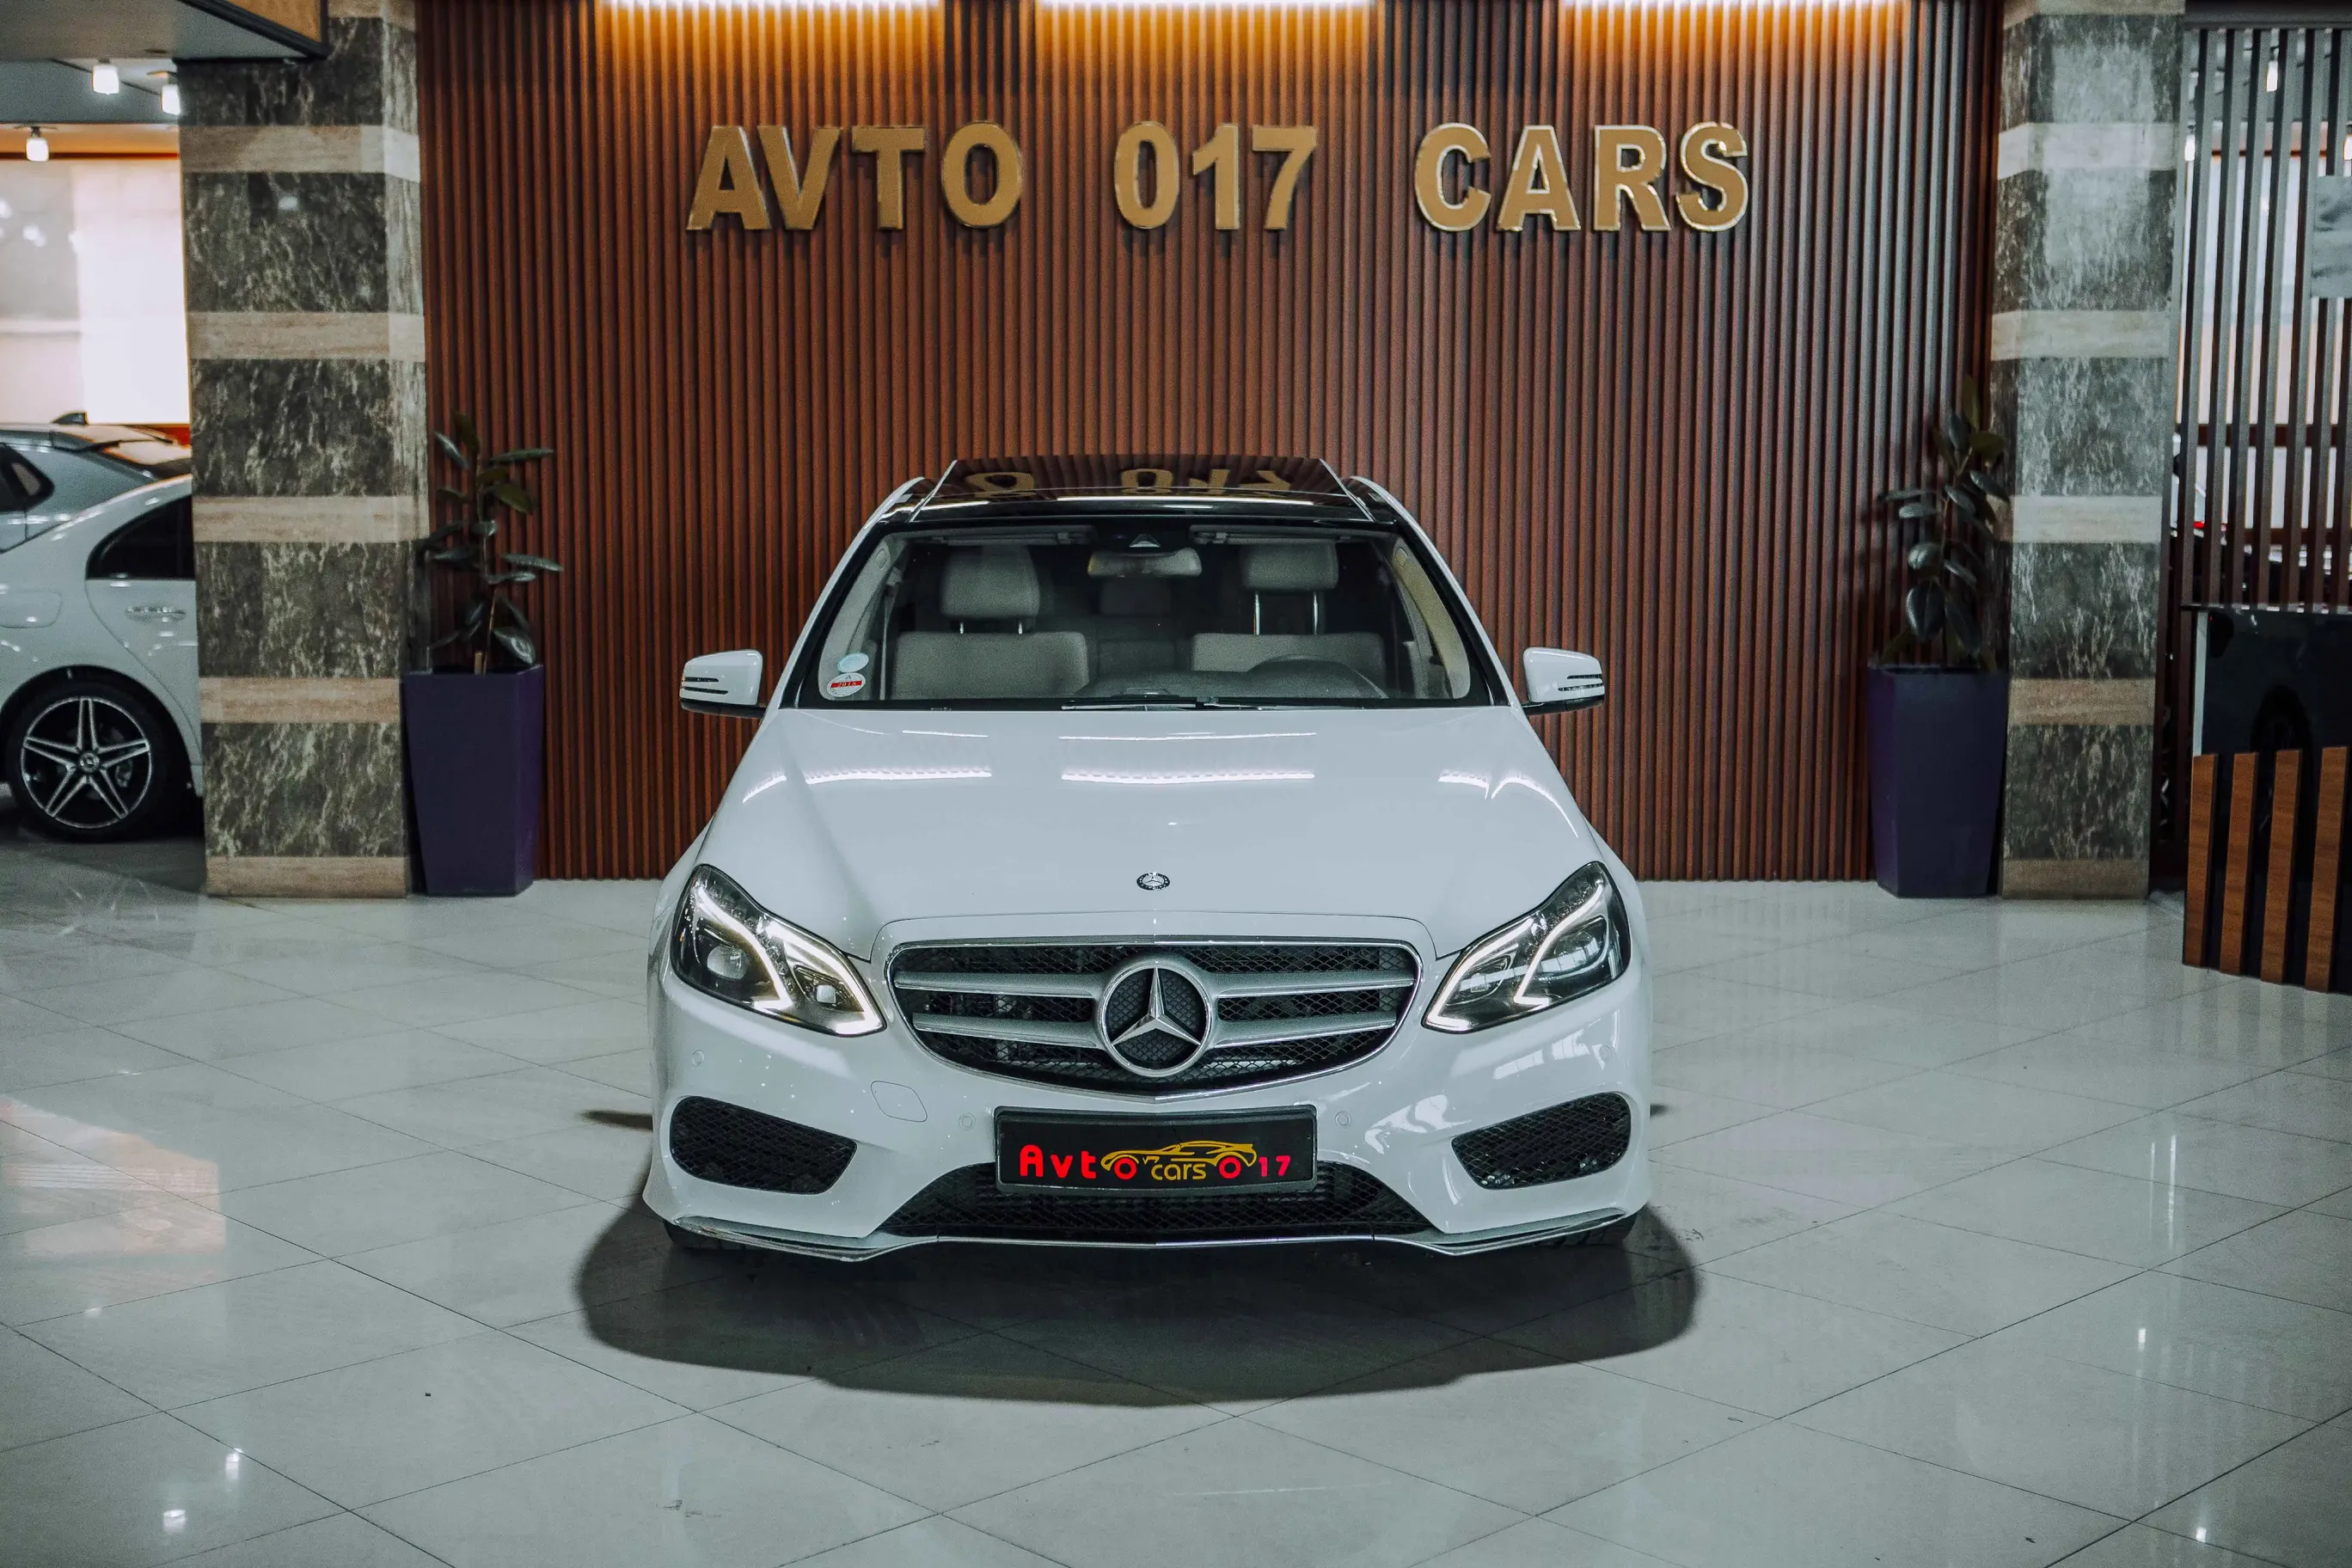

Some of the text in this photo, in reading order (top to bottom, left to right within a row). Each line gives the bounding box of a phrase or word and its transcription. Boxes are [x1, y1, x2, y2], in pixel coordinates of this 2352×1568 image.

[686, 120, 1749, 232] AVTO 017 CARS
[1151, 1163, 1206, 1180] cars
